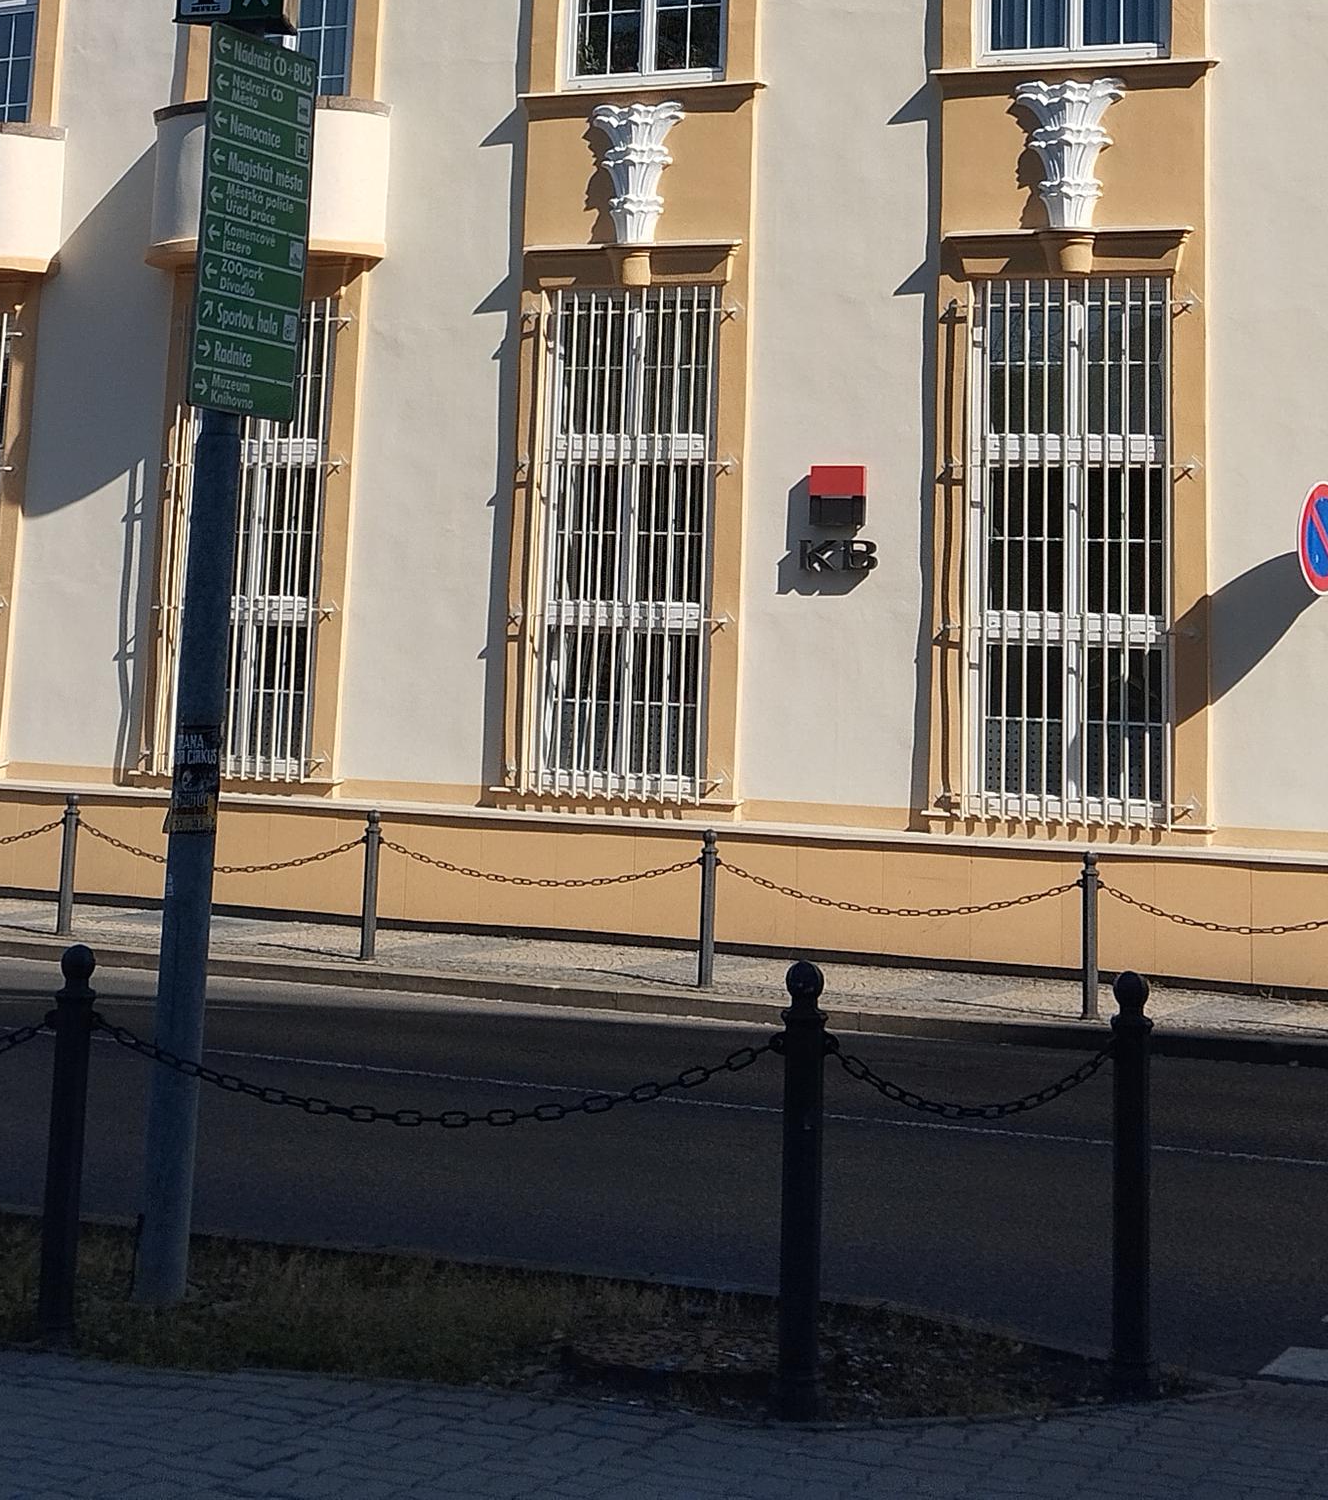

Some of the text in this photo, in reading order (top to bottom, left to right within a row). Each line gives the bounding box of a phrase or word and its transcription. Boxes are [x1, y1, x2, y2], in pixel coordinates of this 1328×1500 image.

[233, 40, 271, 72] Nádraží
[230, 113, 281, 149] Nemocnice
[227, 151, 303, 192] Magistrát města
[222, 235, 252, 256] jezero
[221, 258, 264, 282] ZOOpark
[219, 276, 255, 298] Divadlo
[256, 310, 278, 335] hala
[214, 340, 252, 368] Radnice
[212, 373, 251, 393] Muzeum
[210, 389, 254, 410] Knihovna
[798, 539, 879, 572] KB
